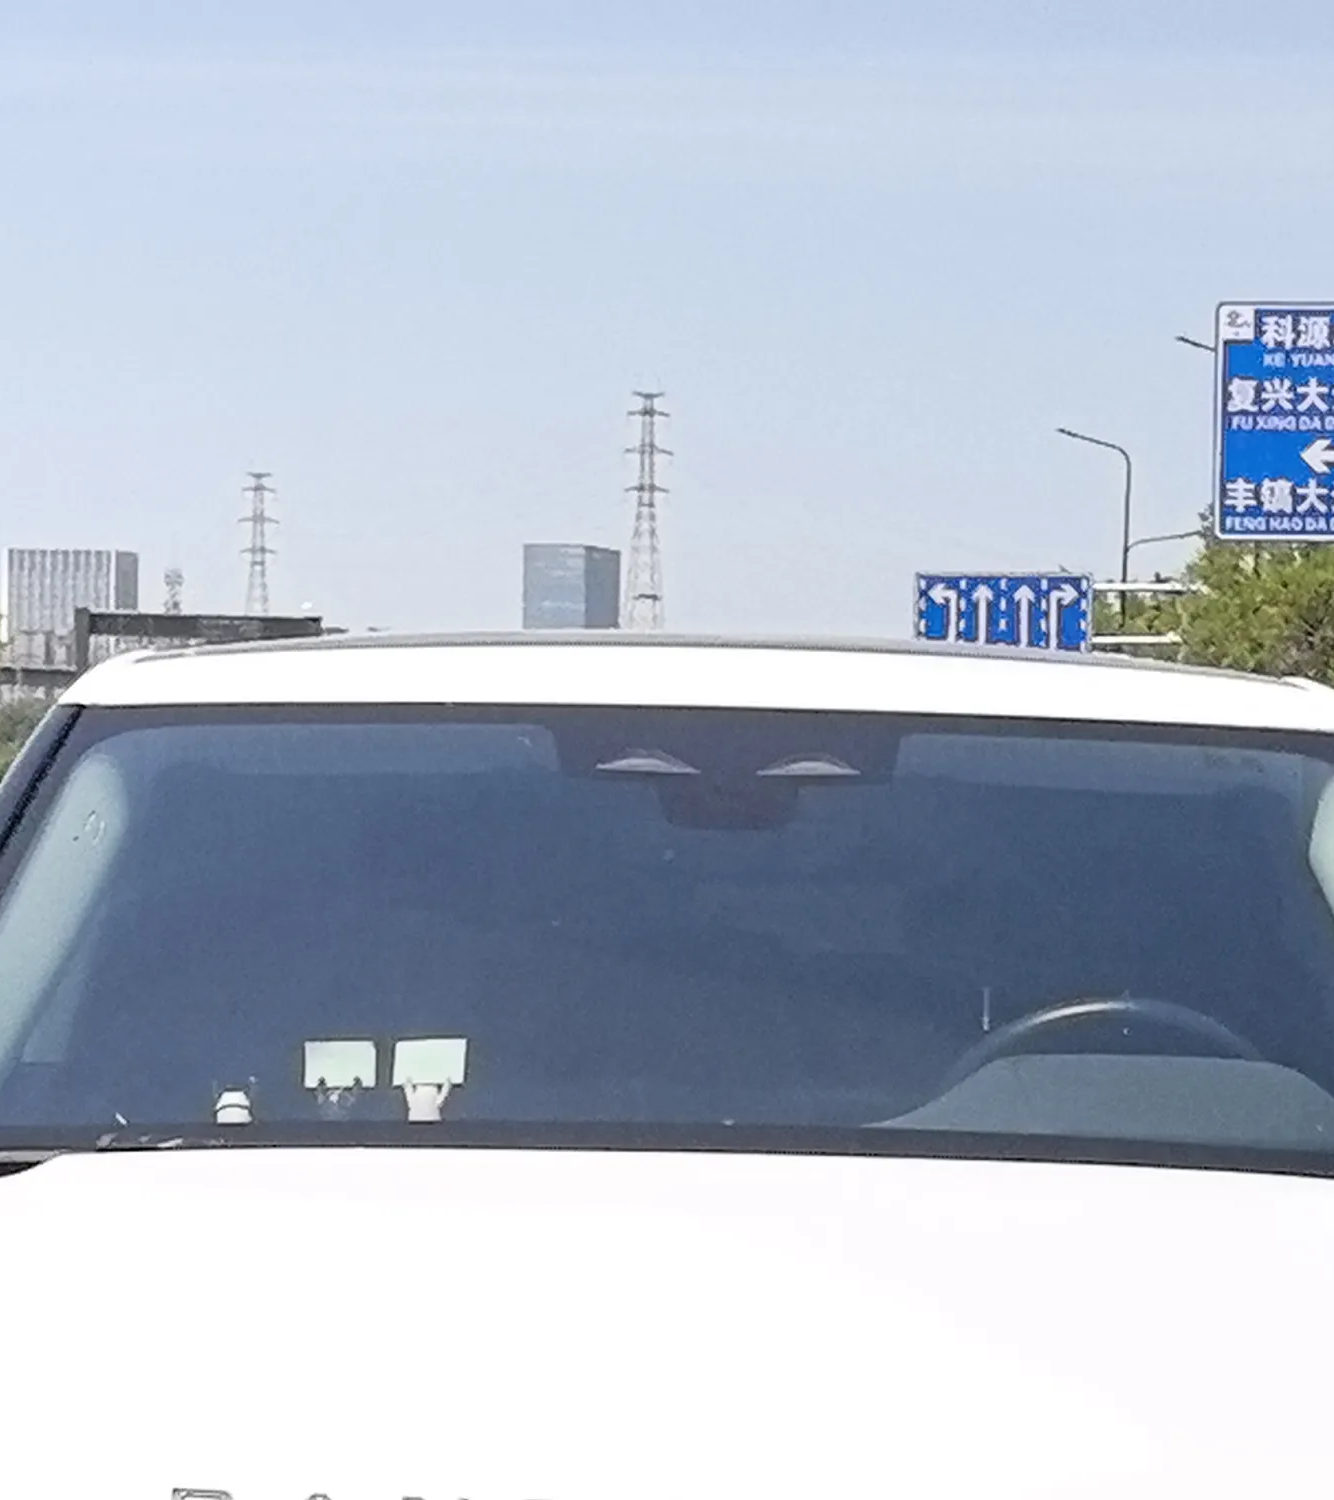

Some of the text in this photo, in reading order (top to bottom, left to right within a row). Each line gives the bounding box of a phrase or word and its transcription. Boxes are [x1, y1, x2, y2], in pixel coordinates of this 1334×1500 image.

[1231, 415, 1252, 430] FU
[1299, 415, 1321, 431] DA
[1305, 516, 1327, 531] DA
